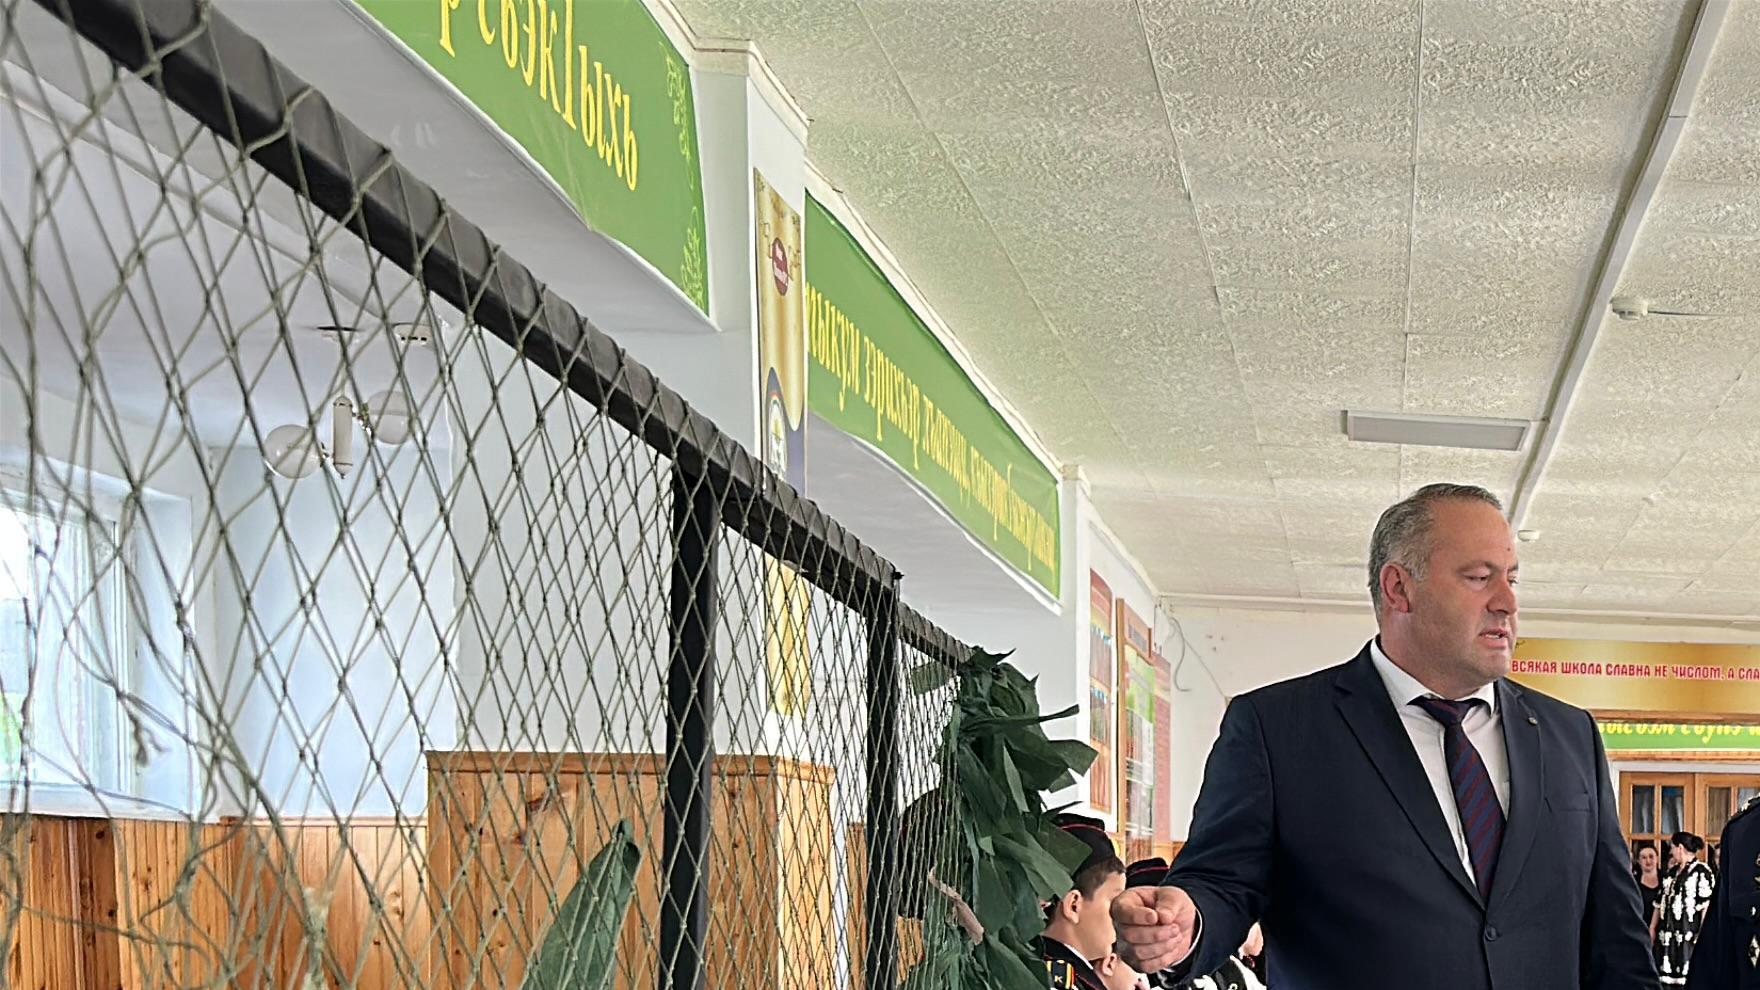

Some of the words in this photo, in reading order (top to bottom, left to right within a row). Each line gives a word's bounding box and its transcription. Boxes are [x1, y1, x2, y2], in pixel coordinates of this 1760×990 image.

[1511, 659, 1557, 674] ВСЯКАЯ
[1561, 661, 1602, 675] ШКОЛА
[1605, 662, 1650, 677] СЛАВНА
[1654, 664, 1668, 677] НЕ
[1727, 667, 1735, 679] А
